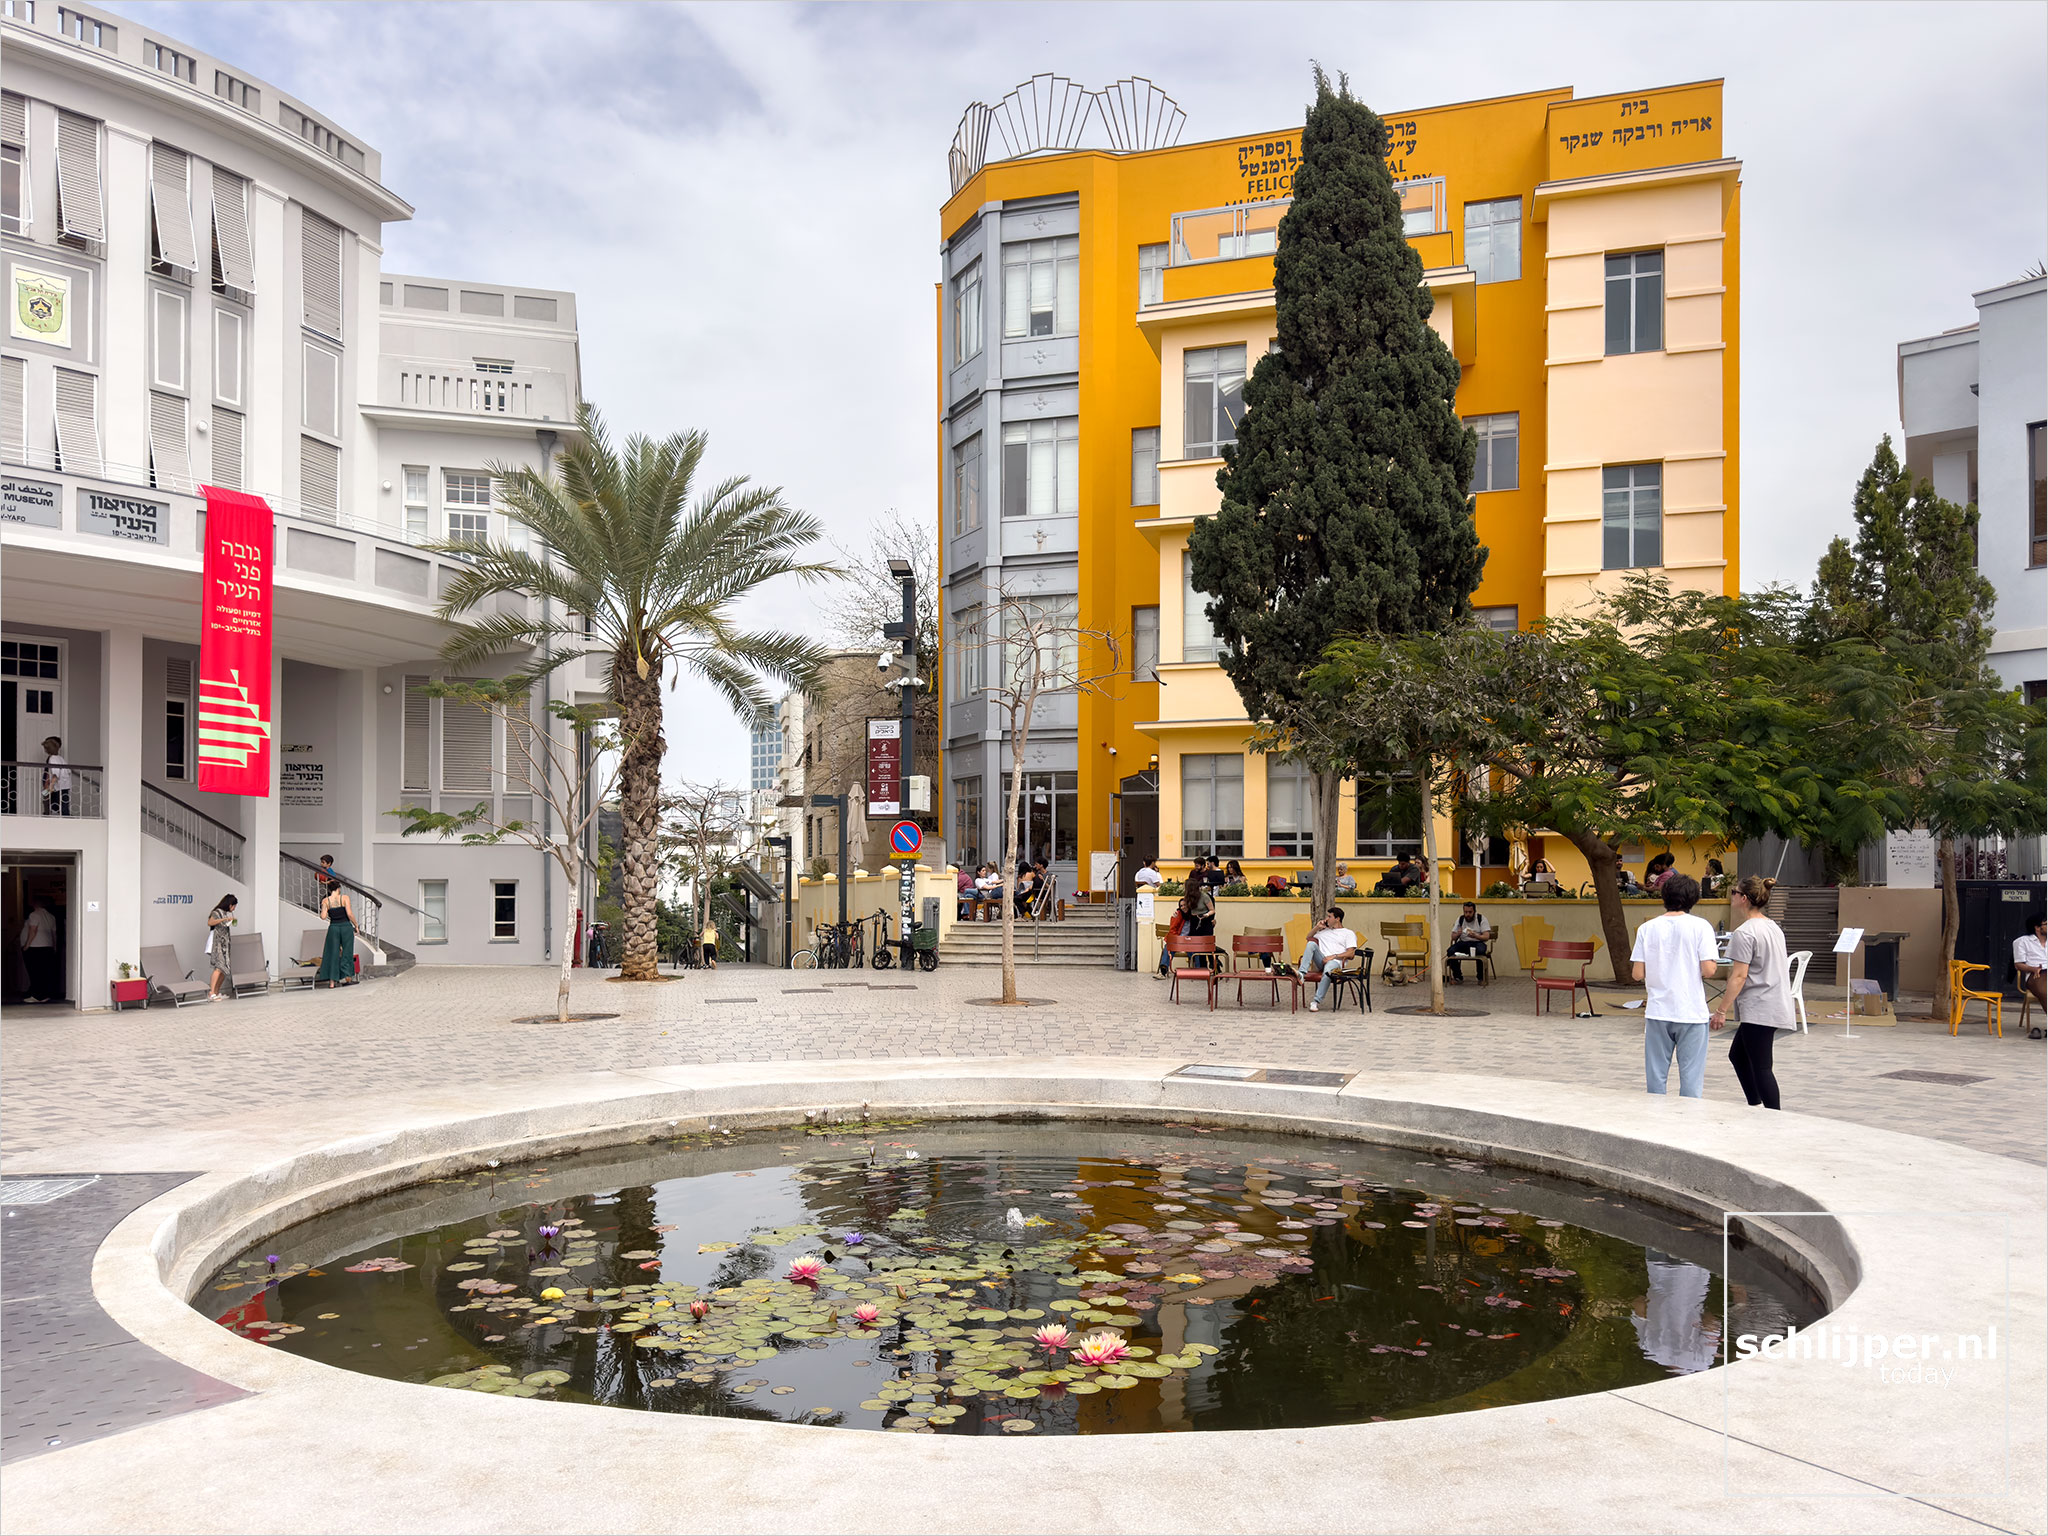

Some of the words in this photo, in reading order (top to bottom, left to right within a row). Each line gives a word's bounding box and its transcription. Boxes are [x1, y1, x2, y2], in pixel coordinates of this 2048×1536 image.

[1621, 100, 1649, 117] בית
[1385, 121, 1416, 138] מרכ
[1612, 123, 1663, 146] ורבקה
[1671, 116, 1712, 135] אריה
[1238, 140, 1292, 161] וספריה
[1560, 131, 1603, 154] שנקר
[1248, 175, 1294, 194] FELICJ
[4, 493, 53, 507] MUSEUM
[18, 485, 53, 497] متحف
[90, 495, 157, 518] מוזיאון
[1, 513, 26, 522] V-YAFO
[110, 514, 157, 533] העיר
[222, 539, 261, 562] גובה
[234, 562, 261, 581] פני
[217, 578, 260, 601] העיר
[232, 617, 261, 627] אזרחיים
[243, 610, 261, 618] דמיון
[285, 763, 323, 772] מוזיאון
[296, 773, 323, 781] העיר
